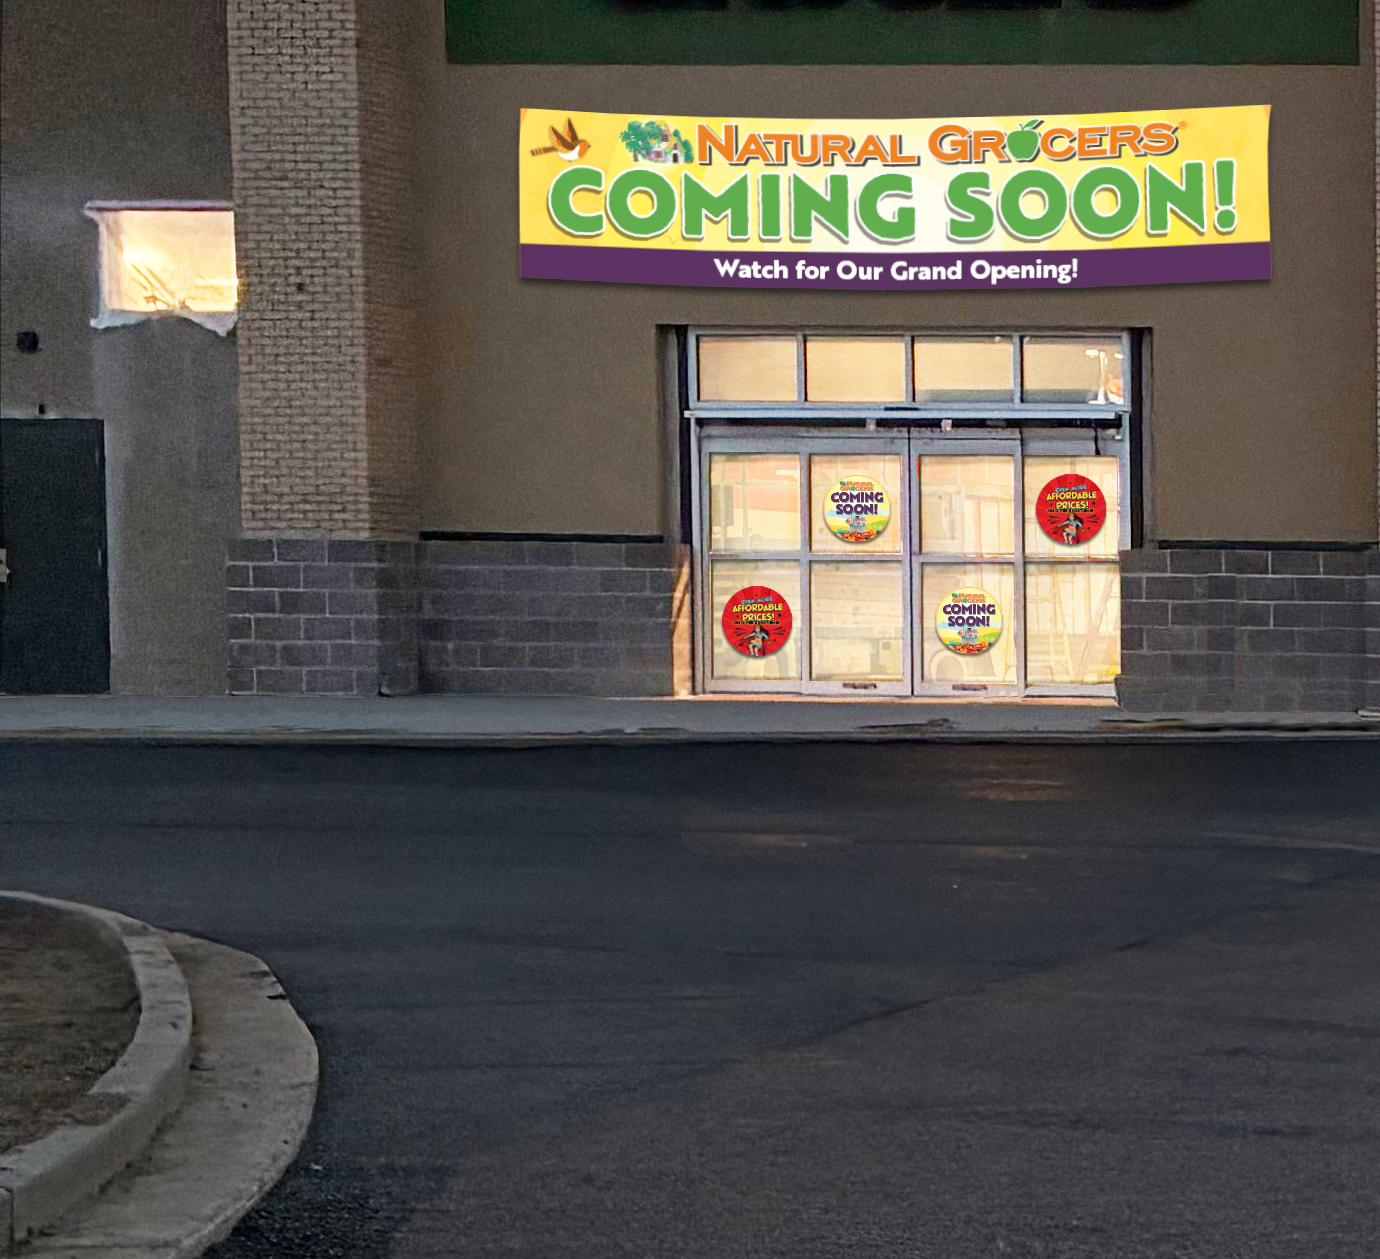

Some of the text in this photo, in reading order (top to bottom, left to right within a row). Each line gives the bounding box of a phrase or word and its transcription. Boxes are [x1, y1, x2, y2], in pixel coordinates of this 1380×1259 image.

[697, 123, 919, 165] NATURAL
[548, 158, 1237, 242] COMING SOON!
[713, 258, 1078, 285] Watch for Our Grand Opening!
[831, 492, 883, 503] COMING
[1046, 491, 1097, 501] AFFORDABLE
[836, 503, 878, 515] SOON!
[1056, 500, 1089, 509] PRICES!
[732, 603, 783, 613] AFFORDABLE
[943, 604, 995, 615] COMING
[742, 612, 775, 621] PRICES!
[948, 615, 990, 627] SOON!
